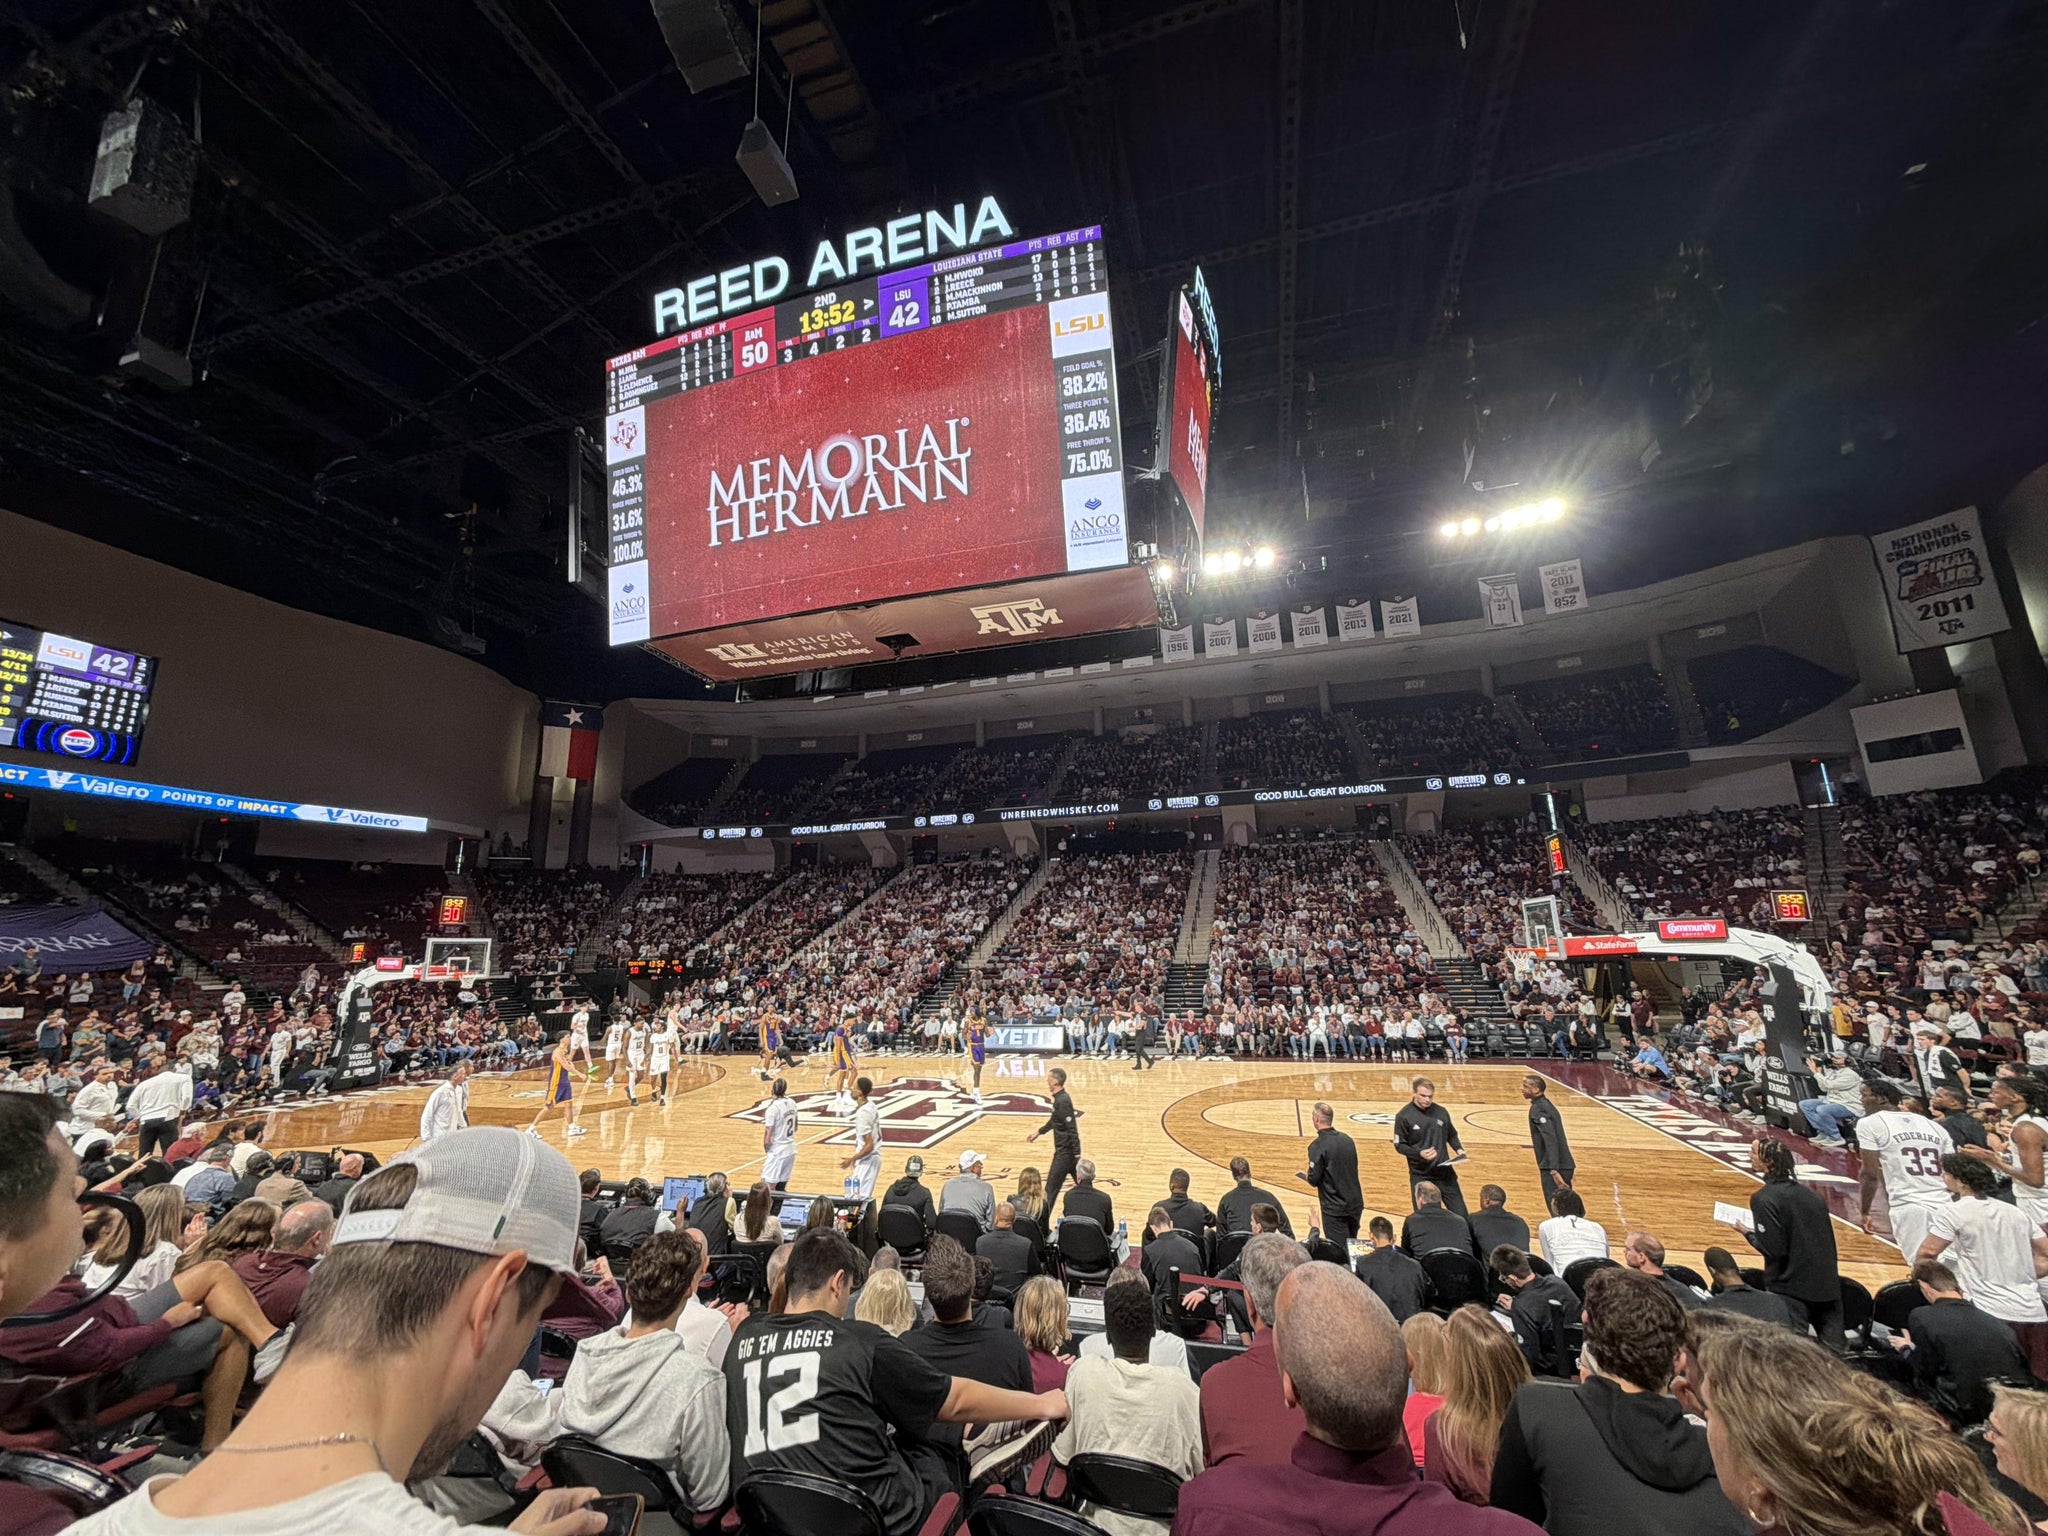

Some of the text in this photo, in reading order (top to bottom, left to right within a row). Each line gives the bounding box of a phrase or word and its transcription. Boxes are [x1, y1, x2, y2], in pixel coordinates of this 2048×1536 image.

[1028, 228, 1094, 251] PTS REB AST PF
[654, 195, 1013, 335] REED ARENA
[933, 248, 1003, 273] LOUISIANA STATE
[934, 243, 1093, 286] 1 M.NWOKO 17 1 3
[934, 252, 1094, 295] 2 J.REECE 0 0 2
[934, 262, 1095, 305] 3 M.MACKINNON 13 2 1
[946, 296, 980, 311] P.TAMBA
[1035, 282, 1042, 292] 2
[1071, 275, 1078, 284] 0
[1089, 272, 1096, 281] 1
[814, 292, 836, 308] 2ND
[894, 288, 911, 302] LSU
[931, 282, 1096, 325] 10 M.SUTTON 3 4 0 1
[799, 300, 855, 334] 13:52
[888, 301, 920, 328] 42
[677, 334, 688, 345] PTS
[705, 325, 715, 337] AST
[719, 321, 727, 332] PF
[1055, 313, 1105, 337] LSU
[744, 326, 763, 342] A&M
[836, 335, 845, 349] 2
[862, 328, 871, 343] 2
[694, 342, 699, 351] 4
[707, 338, 713, 347] 2
[720, 334, 726, 343] 2
[809, 341, 819, 356] 4
[610, 352, 632, 368] TEXAS
[680, 343, 726, 364] 4 1 1
[708, 356, 713, 364] 1
[741, 340, 768, 368] 50
[784, 348, 792, 363] 3
[680, 372, 689, 382] 12
[708, 364, 713, 373] 1
[721, 361, 726, 369] 0
[1063, 359, 1103, 373] FIELD GOAL %
[709, 370, 727, 382] 1 1
[1062, 371, 1108, 397] 38.2%
[1063, 396, 1109, 411] THREE POINT %
[1064, 409, 1110, 435] 36.4%
[1067, 436, 1111, 450] FREE THROW %
[706, 418, 971, 511] MEMORIAL
[1067, 449, 1113, 475] 75.0%
[612, 473, 643, 498] 46.3%
[708, 456, 969, 547] HERMANN
[612, 508, 643, 532] 31.6%
[1071, 514, 1120, 531] ANCO
[1890, 522, 1959, 550] NATIONAL
[613, 539, 644, 563] 100.0%
[1885, 530, 1972, 563] CHAMPIONS
[1550, 574, 1574, 588] 2011
[613, 596, 645, 611] ANCO
[1554, 595, 1577, 608] 852
[1917, 593, 1975, 621] 2011
[1344, 618, 1367, 630] 2013
[1388, 614, 1413, 625] 2021
[1252, 630, 1277, 643] 2008
[1298, 624, 1321, 637] 2010
[763, 631, 854, 649] AMERICAN
[770, 638, 862, 655] CAMPUS
[1209, 636, 1232, 648] 2007
[47, 645, 85, 661] LSU
[727, 653, 814, 669] Where students
[92, 653, 129, 677] 42
[133, 676, 143, 685] 2
[64, 737, 92, 746] PEPSI
[1448, 774, 1487, 786] UNREINED
[1254, 783, 1386, 801] GOOD BULL. GREAT BOURBON.
[80, 777, 402, 828] Valero POINTS OF IMPACT Valero
[1167, 796, 1199, 807] UNREINED
[1001, 803, 1119, 820] UNREINEDWHISKEY.COM
[791, 826, 812, 835] GOOD
[830, 823, 851, 833] GREAT
[852, 820, 886, 832] BOURBON.
[445, 898, 464, 907] 13:52
[1778, 894, 1803, 904] 13:52
[443, 907, 460, 921] 30
[1782, 904, 1800, 917] 30
[1666, 922, 1717, 935] Community
[674, 965, 683, 973] 42
[994, 1028, 1044, 1045] YETI
[636, 1041, 642, 1049] 12
[348, 1051, 373, 1060] WELLS
[348, 1059, 372, 1067] FARGO
[1766, 1071, 1789, 1084] WELLS
[1768, 1082, 1790, 1096] FARGO
[1594, 1094, 1743, 1137] TEXAS
[787, 1118, 793, 1137] 2
[1892, 1131, 1940, 1145] FEDERIKO
[1901, 1147, 1943, 1176] 33
[738, 1329, 834, 1360] GIG 'EM AGGIES
[743, 1350, 821, 1458] 12
